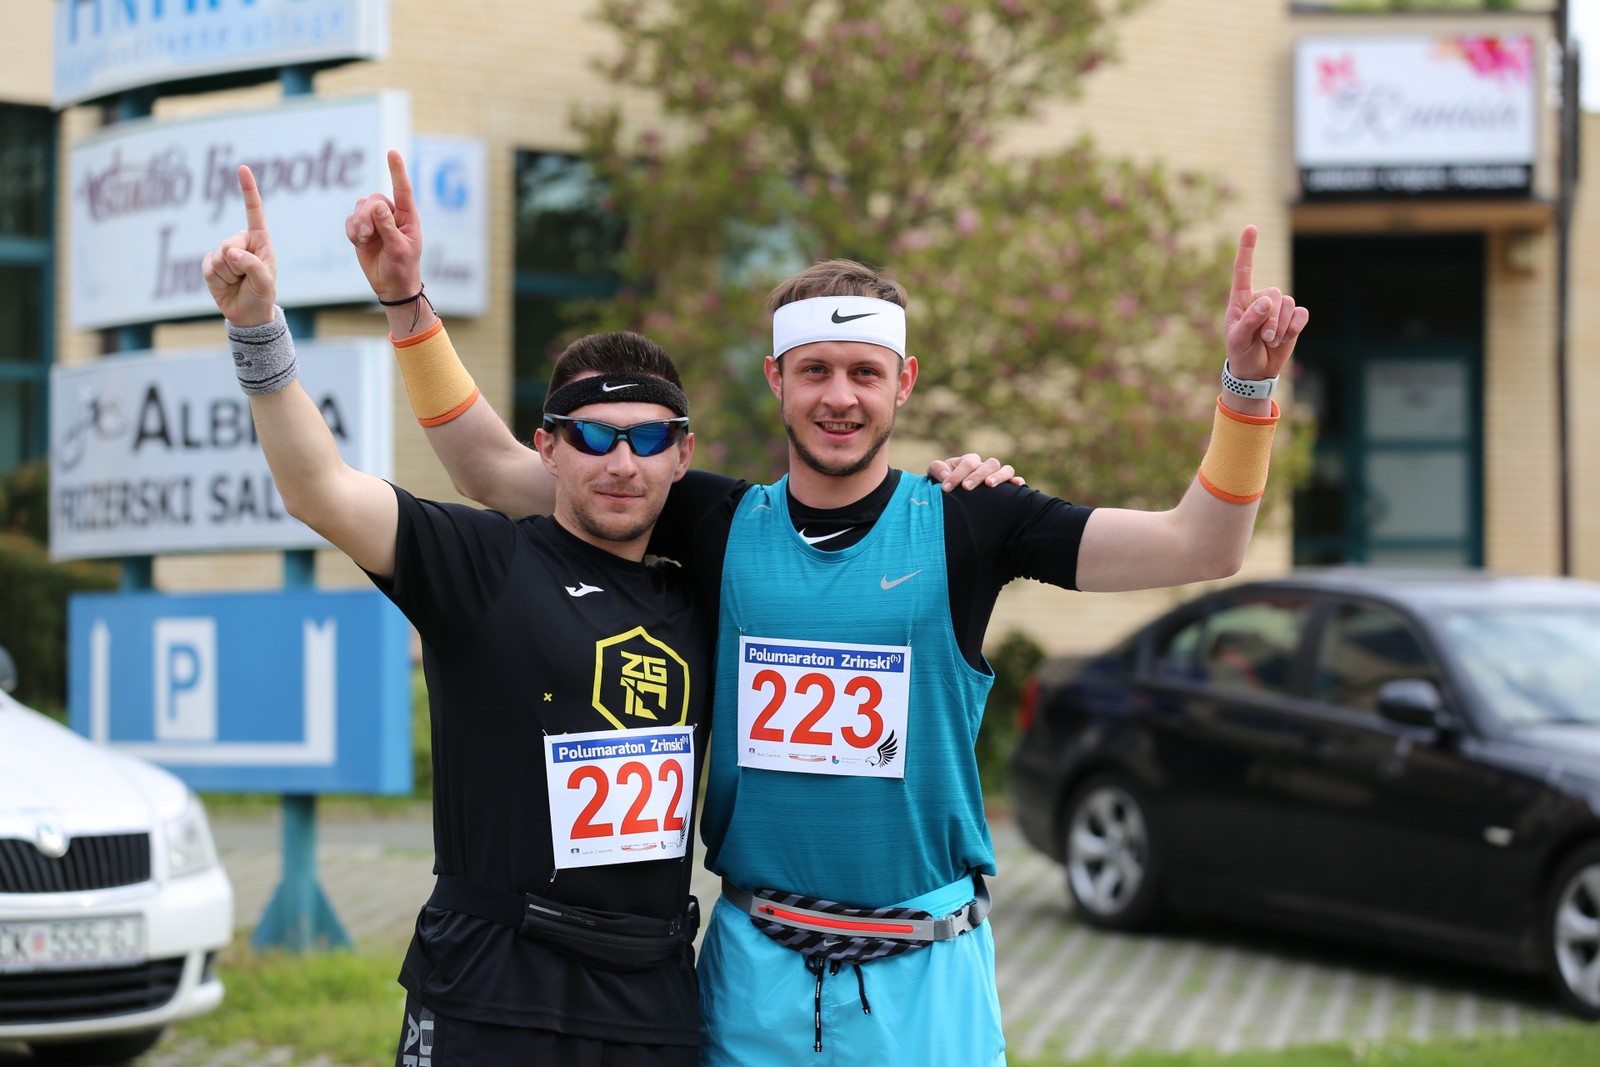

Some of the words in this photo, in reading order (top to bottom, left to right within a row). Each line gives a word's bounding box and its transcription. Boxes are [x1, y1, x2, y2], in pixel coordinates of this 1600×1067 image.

[135, 383, 349, 449] ALBA
[168, 643, 201, 723] P
[749, 647, 835, 667] Polumaraton
[749, 669, 884, 749] 223
[558, 742, 646, 760] Polumaraton
[567, 758, 684, 840] 222
